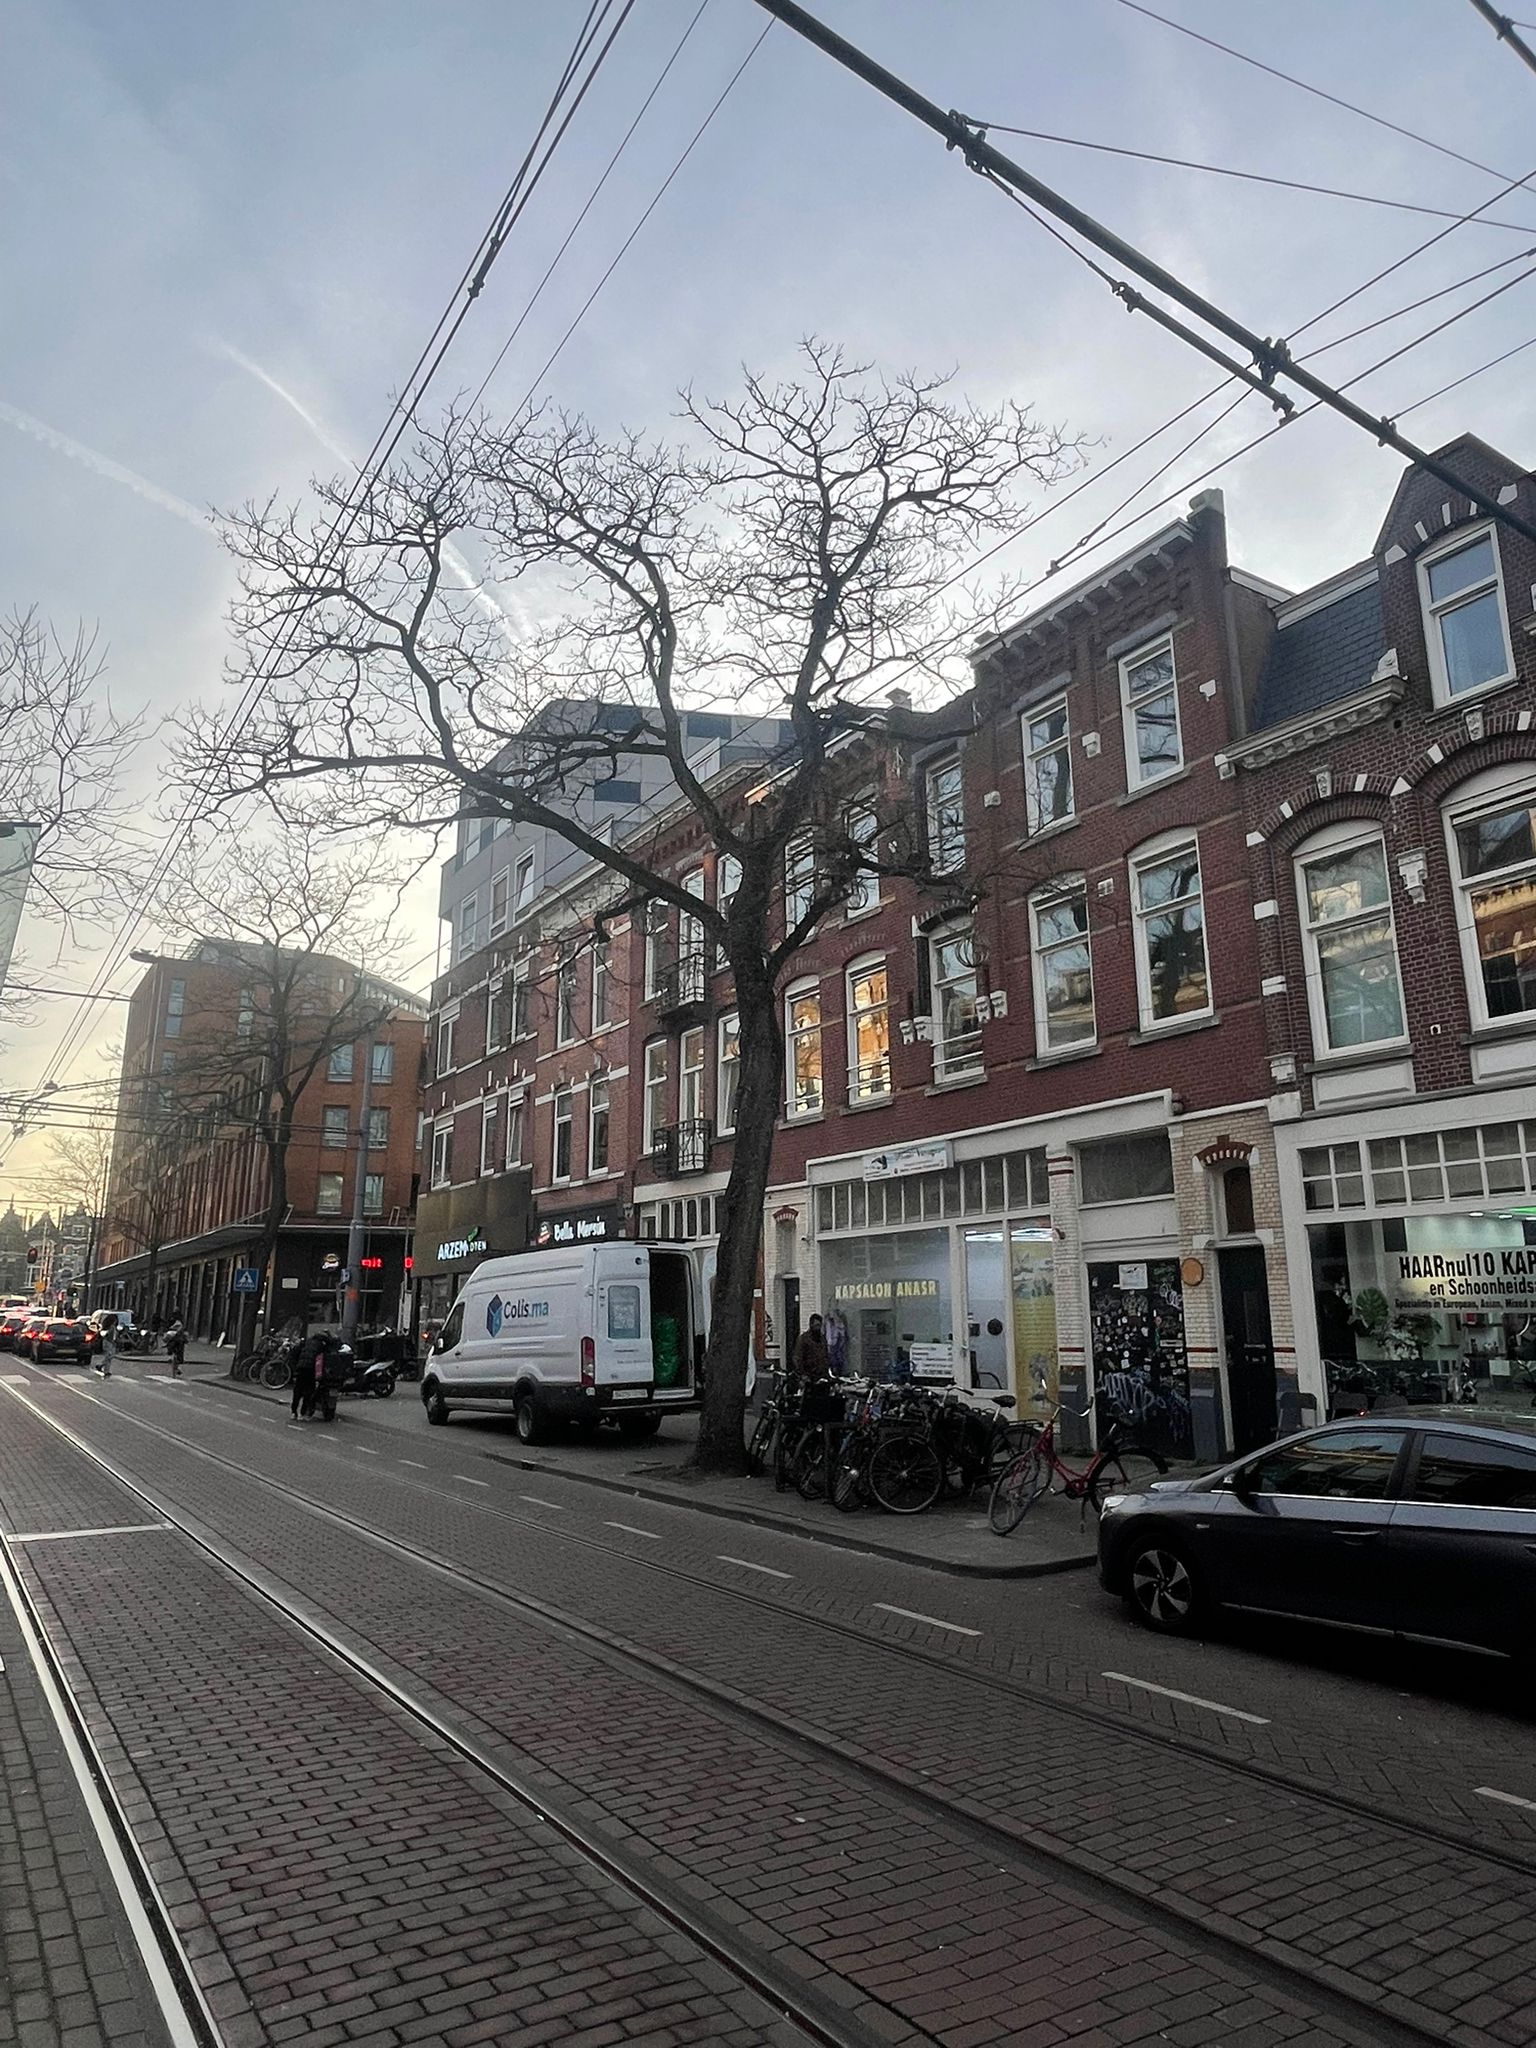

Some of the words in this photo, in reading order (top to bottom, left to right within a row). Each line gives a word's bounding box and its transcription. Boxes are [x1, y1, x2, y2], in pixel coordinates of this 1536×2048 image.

[1399, 1252, 1495, 1278] HAARnul10
[834, 1282, 892, 1300] KAPSALON
[1430, 1284, 1445, 1295] en
[504, 1299, 549, 1319] Colis.ma
